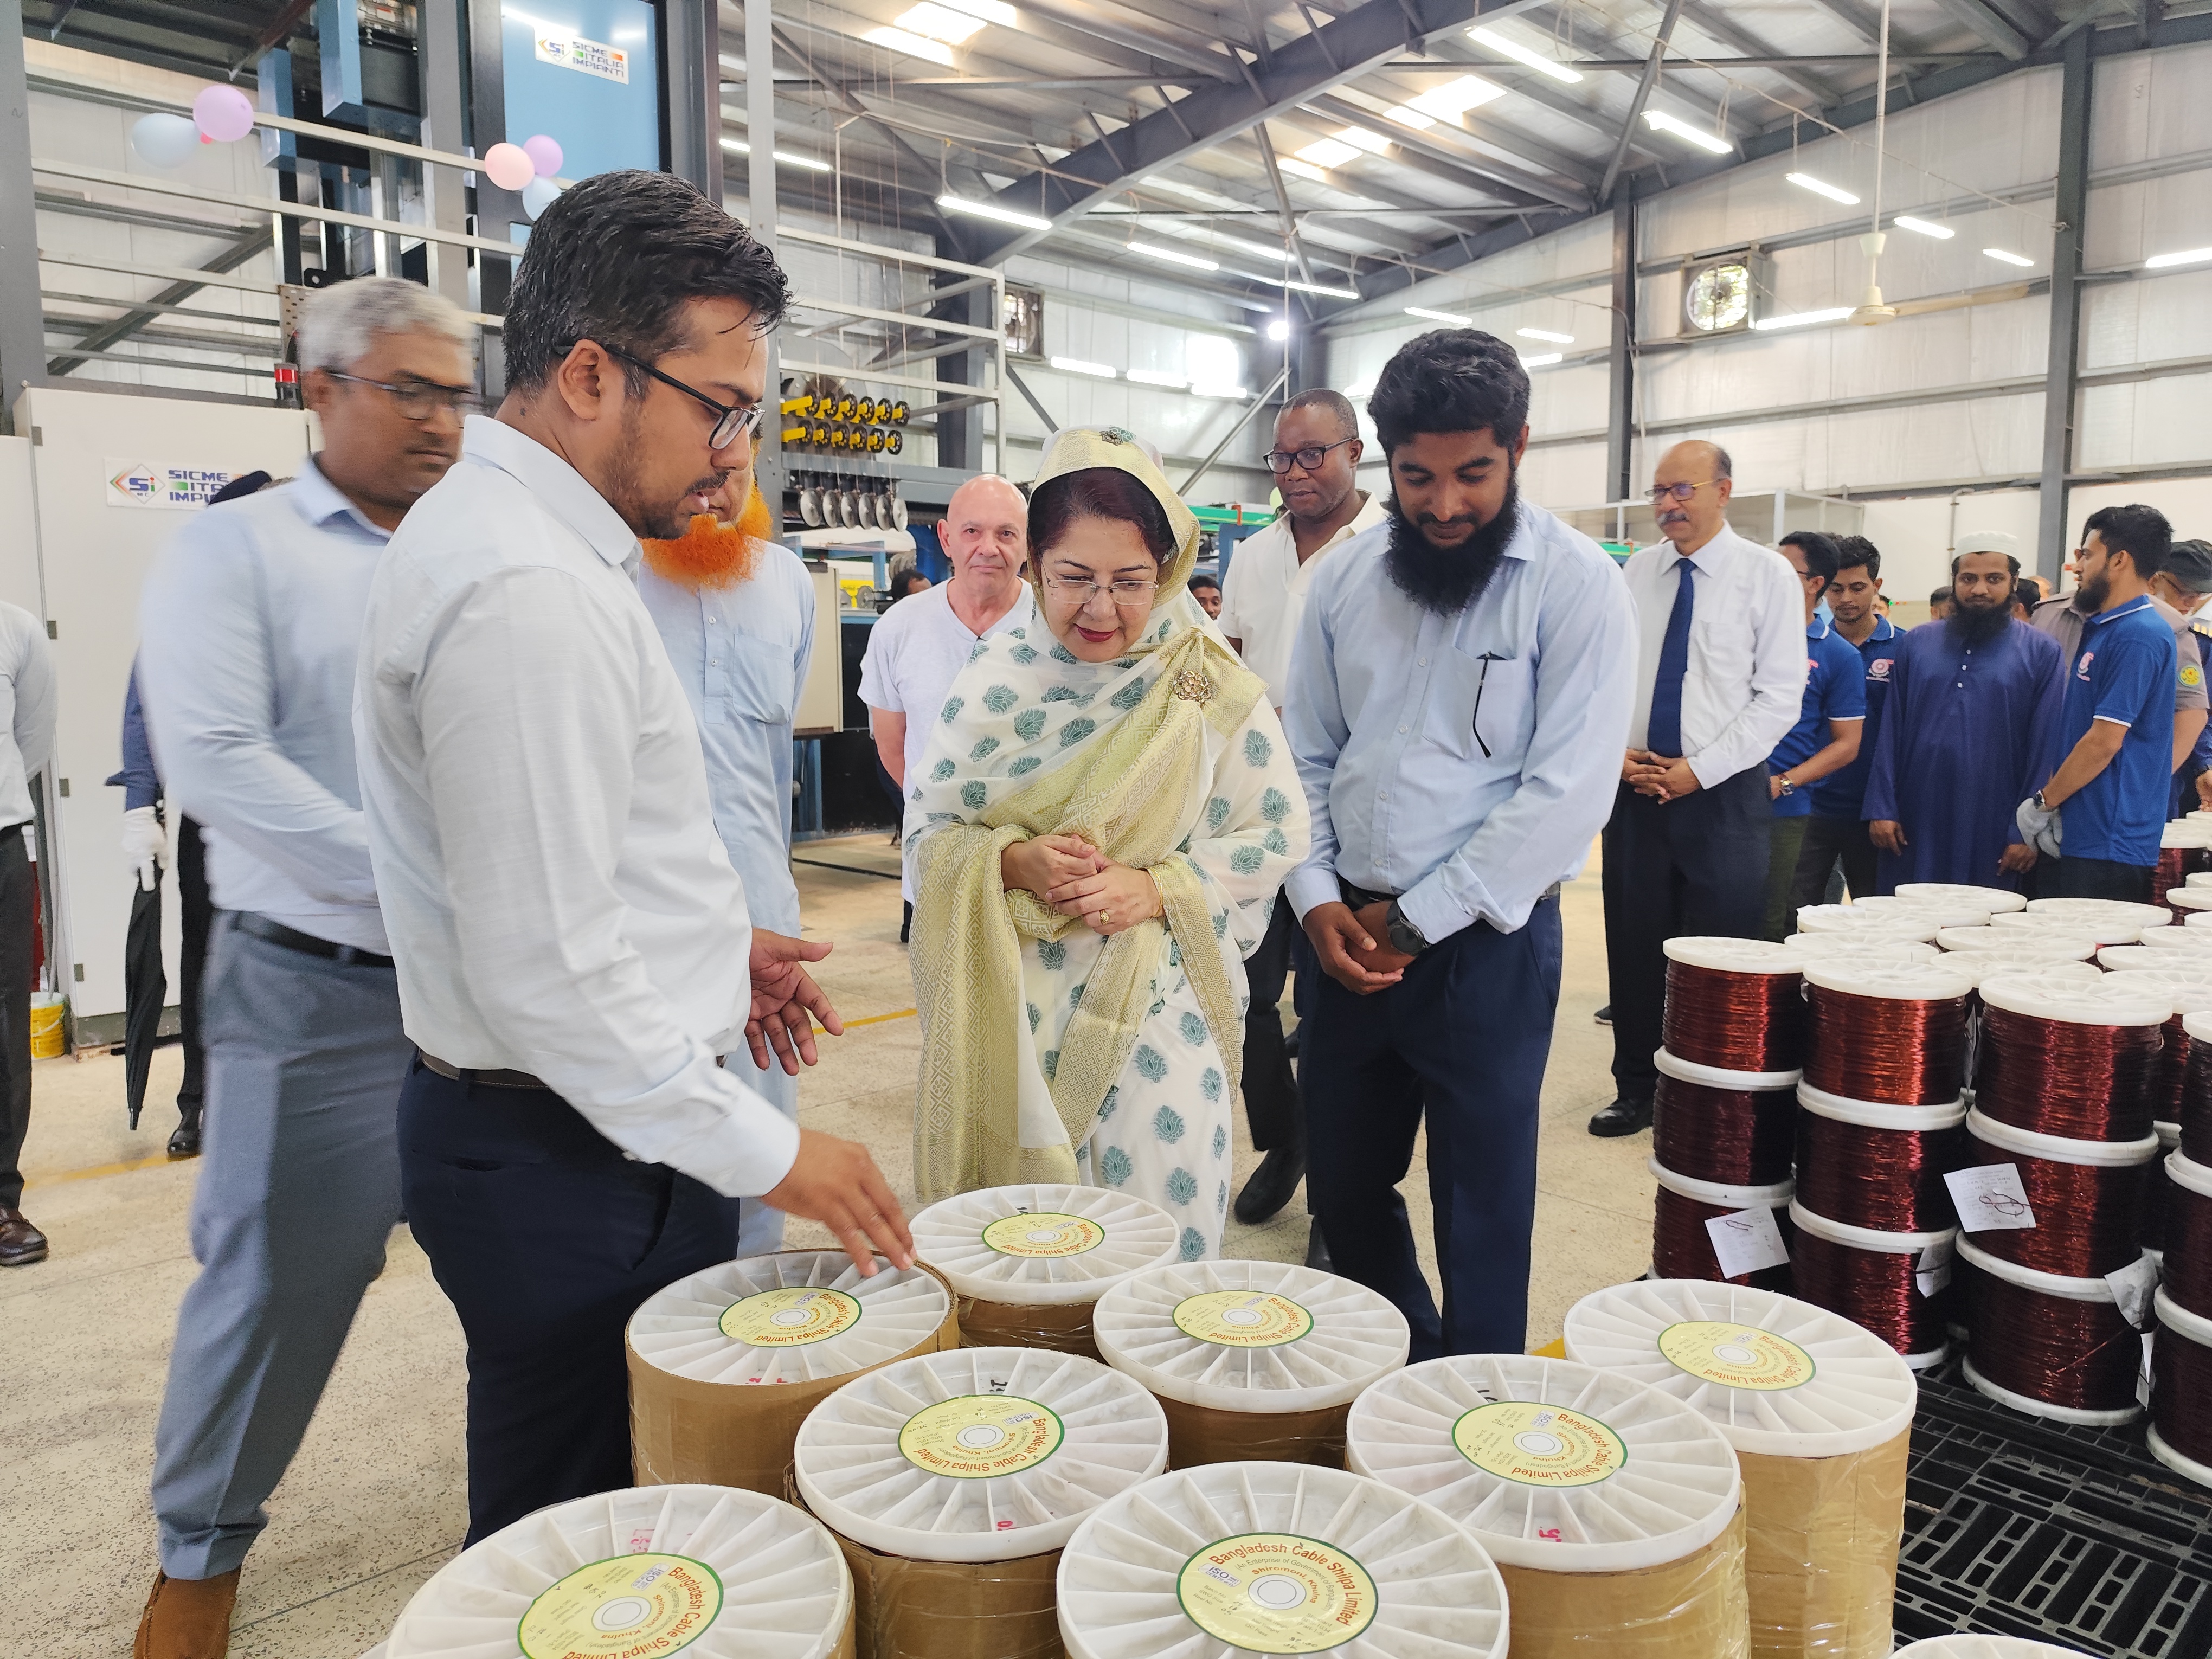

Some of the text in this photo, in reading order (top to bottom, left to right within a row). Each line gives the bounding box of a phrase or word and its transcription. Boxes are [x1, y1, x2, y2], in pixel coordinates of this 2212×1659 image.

[572, 41, 608, 57] SICME
[573, 57, 624, 78] IMPIANTI
[585, 53, 624, 69] ITALIA
[129, 477, 155, 492] Si
[168, 470, 229, 483] SICME
[190, 482, 224, 492] ITA
[819, 1293, 849, 1315] Bangladesh
[828, 1316, 847, 1328] Cable
[1209, 1297, 1300, 1342] Bangladesh Cable Shilpa Limited
[796, 1328, 829, 1339] Shilpa
[1759, 1335, 1799, 1366] Bangladesh
[1703, 1369, 1748, 1384] Limited
[1779, 1365, 1801, 1378] Cable
[1014, 1414, 1034, 1422] ISO
[1539, 1413, 1553, 1424] ISO
[916, 1418, 1046, 1471] Bangladesh Cable Shilpa Limited
[1511, 1413, 1611, 1480] Bangladesh Cable Shilpa Limited
[973, 1450, 1011, 1460] Government
[643, 1568, 665, 1583] ISO
[1207, 1566, 1231, 1579] ISO
[1290, 1559, 1327, 1580] Government
[1204, 1571, 1236, 1587] CERTIFIED
[1209, 1543, 1361, 1625] Bangladesh Cable Shilpa Limited
[668, 1566, 704, 1609] Bangladesh
[1307, 1579, 1317, 1603] Khulna
[667, 1612, 700, 1637] Cable
[601, 1629, 641, 1639] Khulna
[622, 1637, 670, 1659] Shilpa
